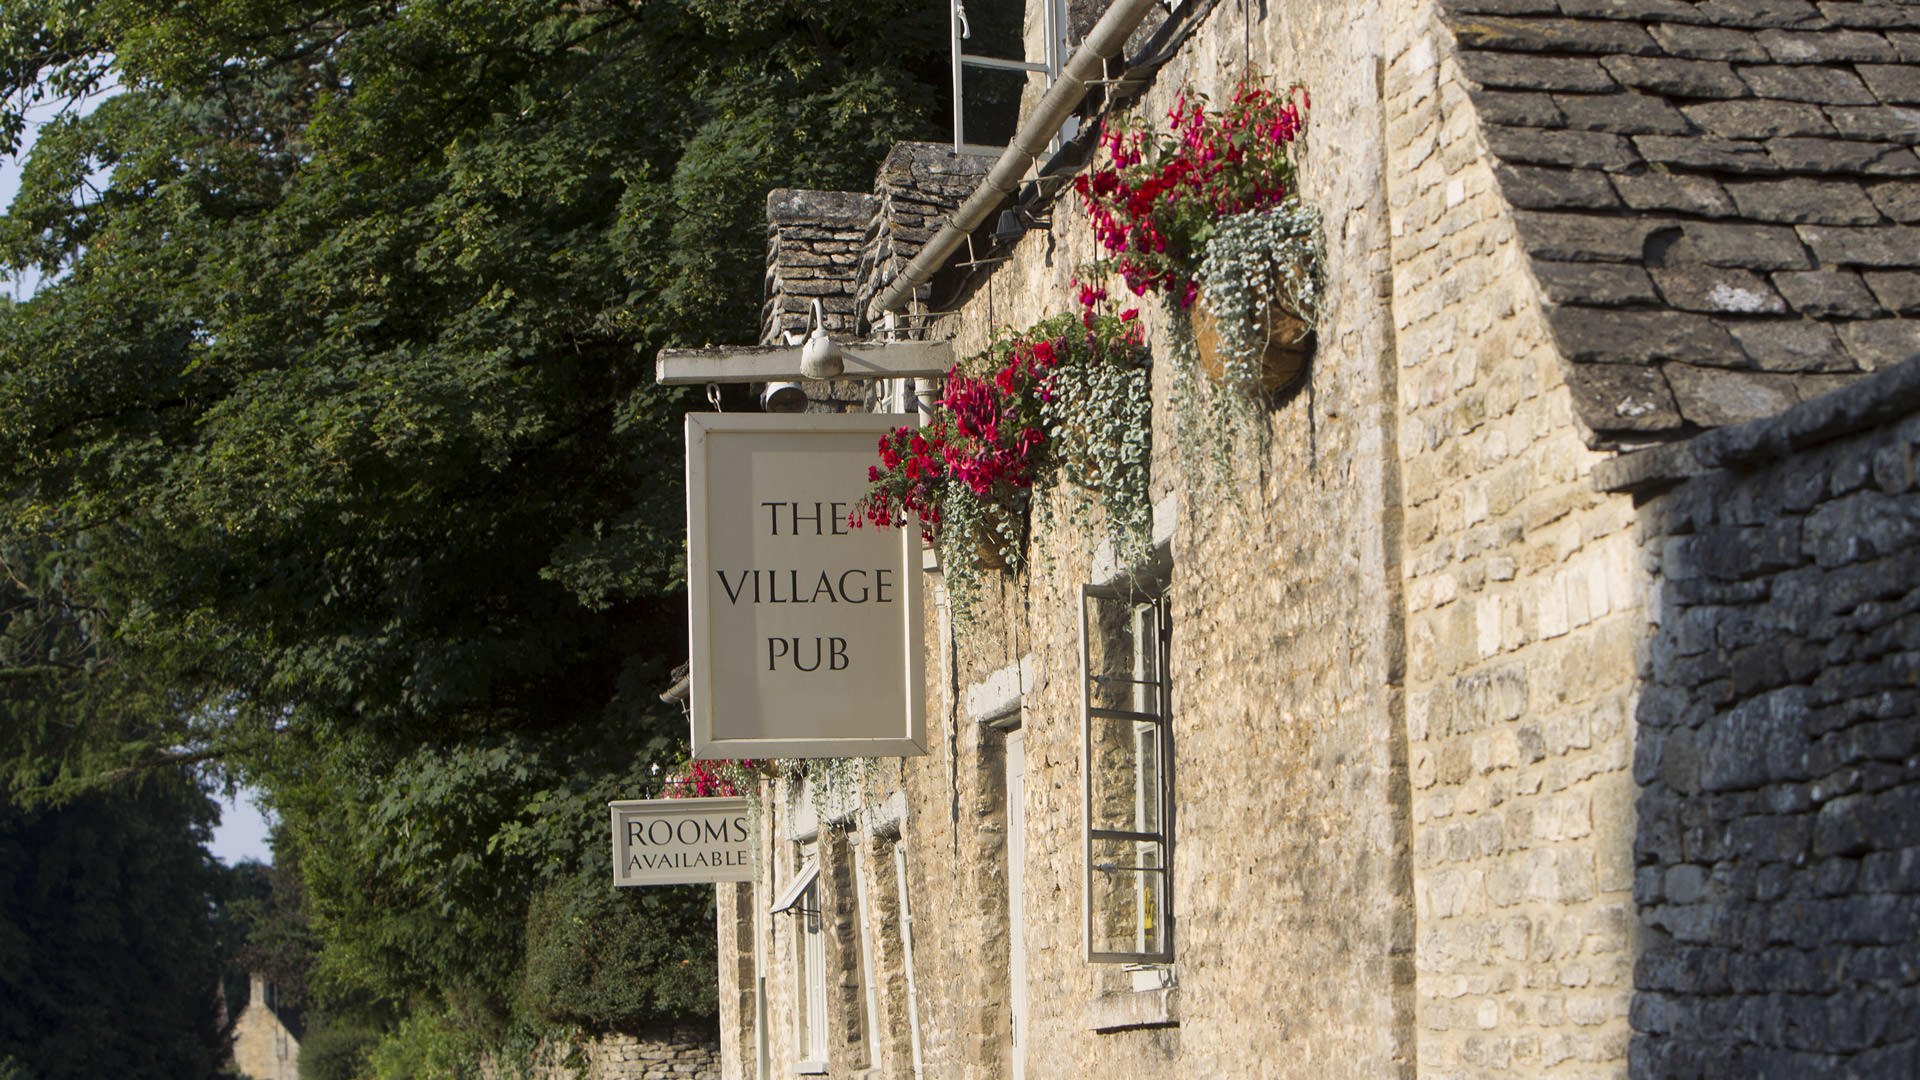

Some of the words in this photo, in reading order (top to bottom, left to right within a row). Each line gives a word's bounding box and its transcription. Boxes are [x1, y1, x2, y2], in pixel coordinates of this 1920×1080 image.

[761, 502, 849, 536] THE
[716, 569, 893, 606] VILLAGE
[767, 637, 850, 672] PUB
[627, 817, 748, 847] ROOMS
[628, 850, 747, 870] AVAILABLE
